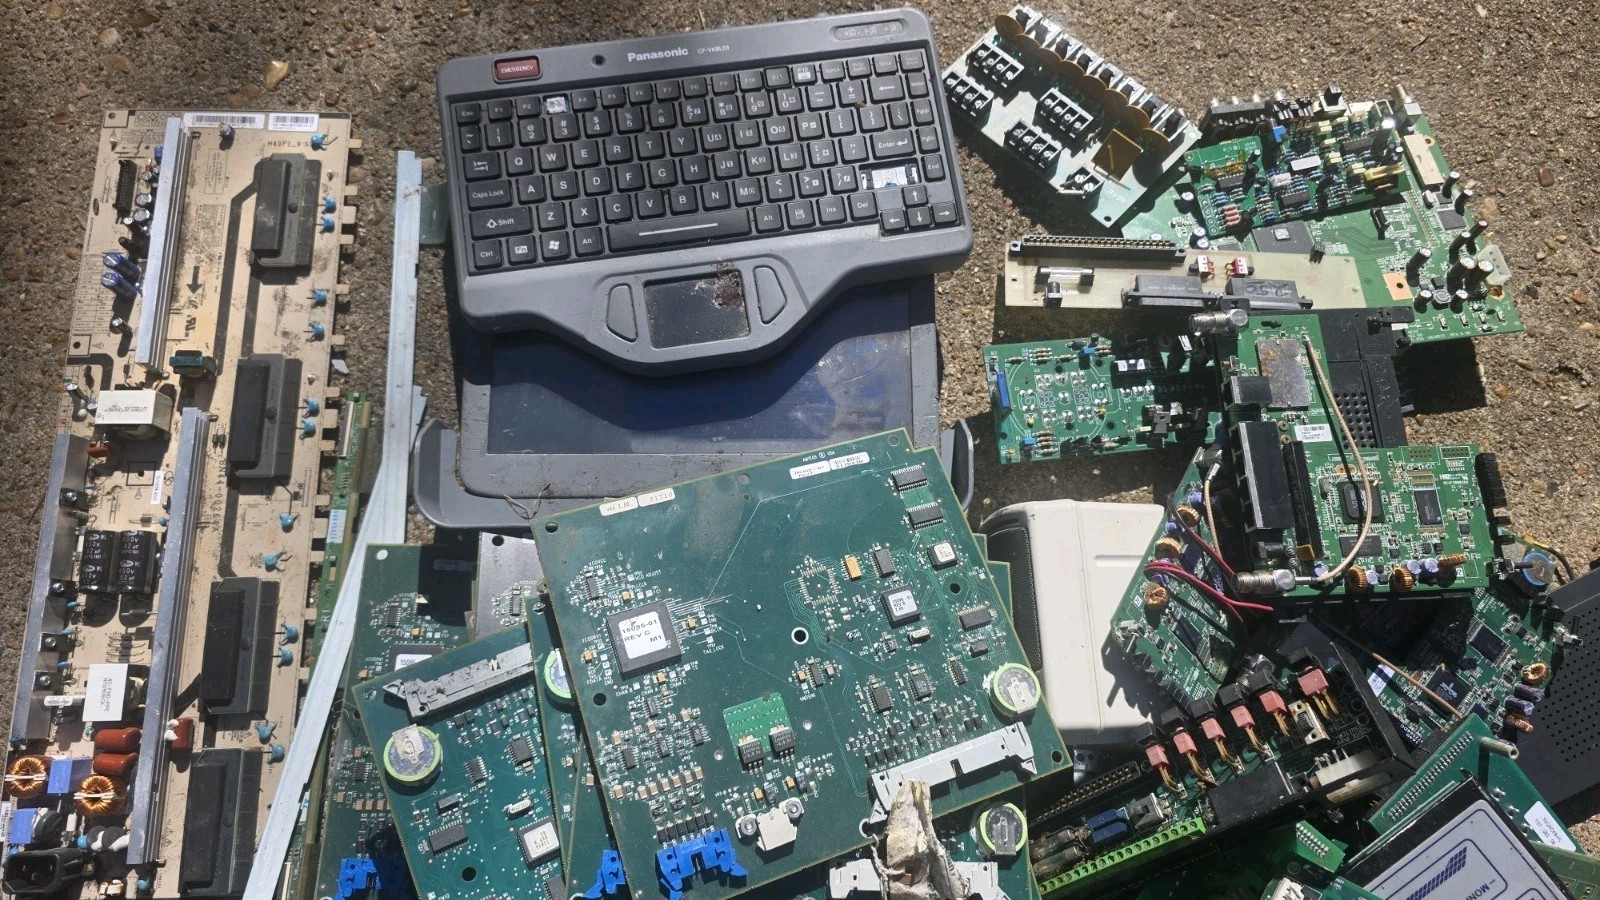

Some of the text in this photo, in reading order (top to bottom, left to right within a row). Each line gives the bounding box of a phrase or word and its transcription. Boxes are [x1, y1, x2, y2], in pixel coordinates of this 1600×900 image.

[628, 46, 689, 63] Panasonic
[501, 65, 533, 74] EMERGENCY
[771, 126, 778, 134] O
[802, 122, 808, 130] P
[515, 157, 522, 165] Q
[658, 169, 666, 177] G
[691, 165, 698, 173] H
[560, 181, 567, 189] S
[593, 177, 600, 185] D
[528, 185, 535, 193] A
[581, 208, 588, 216] X
[614, 204, 620, 212] C
[548, 212, 554, 220] Z
[624, 633, 644, 643] REV
[650, 635, 663, 644] M1
